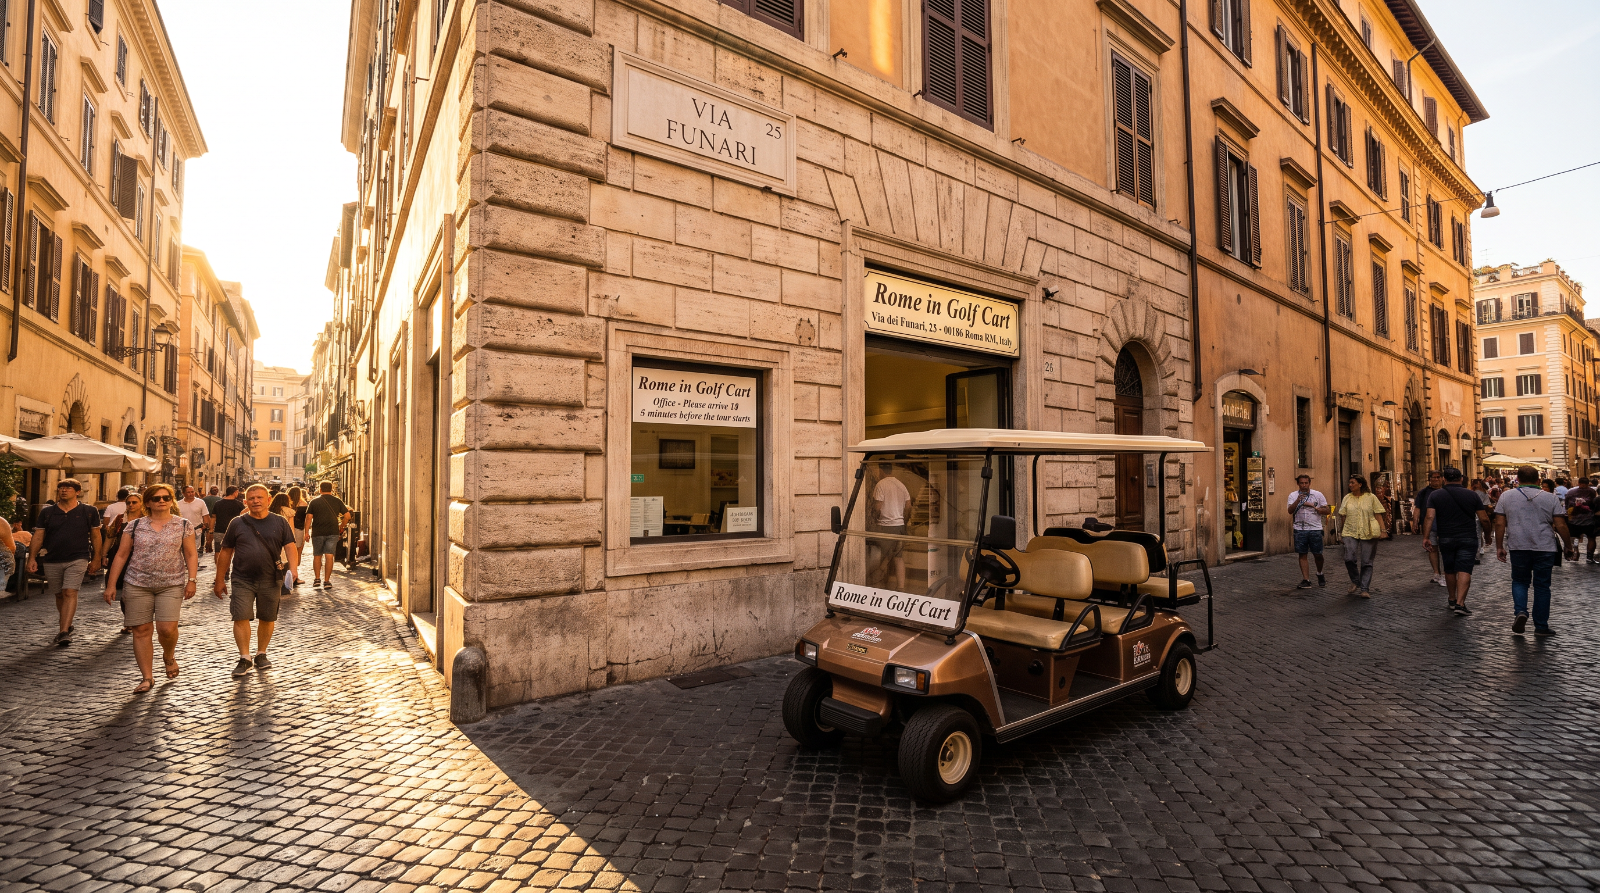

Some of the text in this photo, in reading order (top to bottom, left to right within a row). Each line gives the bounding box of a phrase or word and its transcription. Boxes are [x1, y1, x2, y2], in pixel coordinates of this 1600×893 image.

[692, 97, 733, 130] VIA
[666, 119, 757, 165] FUNARI
[765, 123, 782, 139] 25
[873, 282, 1011, 329] Rome in Golf Cart
[871, 311, 885, 324] Via
[886, 314, 899, 326] dei
[900, 316, 927, 333] Funari,
[944, 325, 964, 338] 00186
[965, 329, 983, 341] Roma
[984, 333, 998, 345] RM,
[999, 336, 1012, 348] Italy
[1045, 361, 1054, 373] 26
[638, 376, 751, 399] Rome in Golf Cart
[647, 409, 677, 418] minutes
[679, 411, 703, 421] before
[703, 412, 715, 420] the
[716, 413, 731, 421] tour
[653, 397, 676, 408] Office
[683, 399, 706, 409] Please
[707, 402, 728, 410] arrive
[834, 586, 952, 621] Rome in Golf Cart
